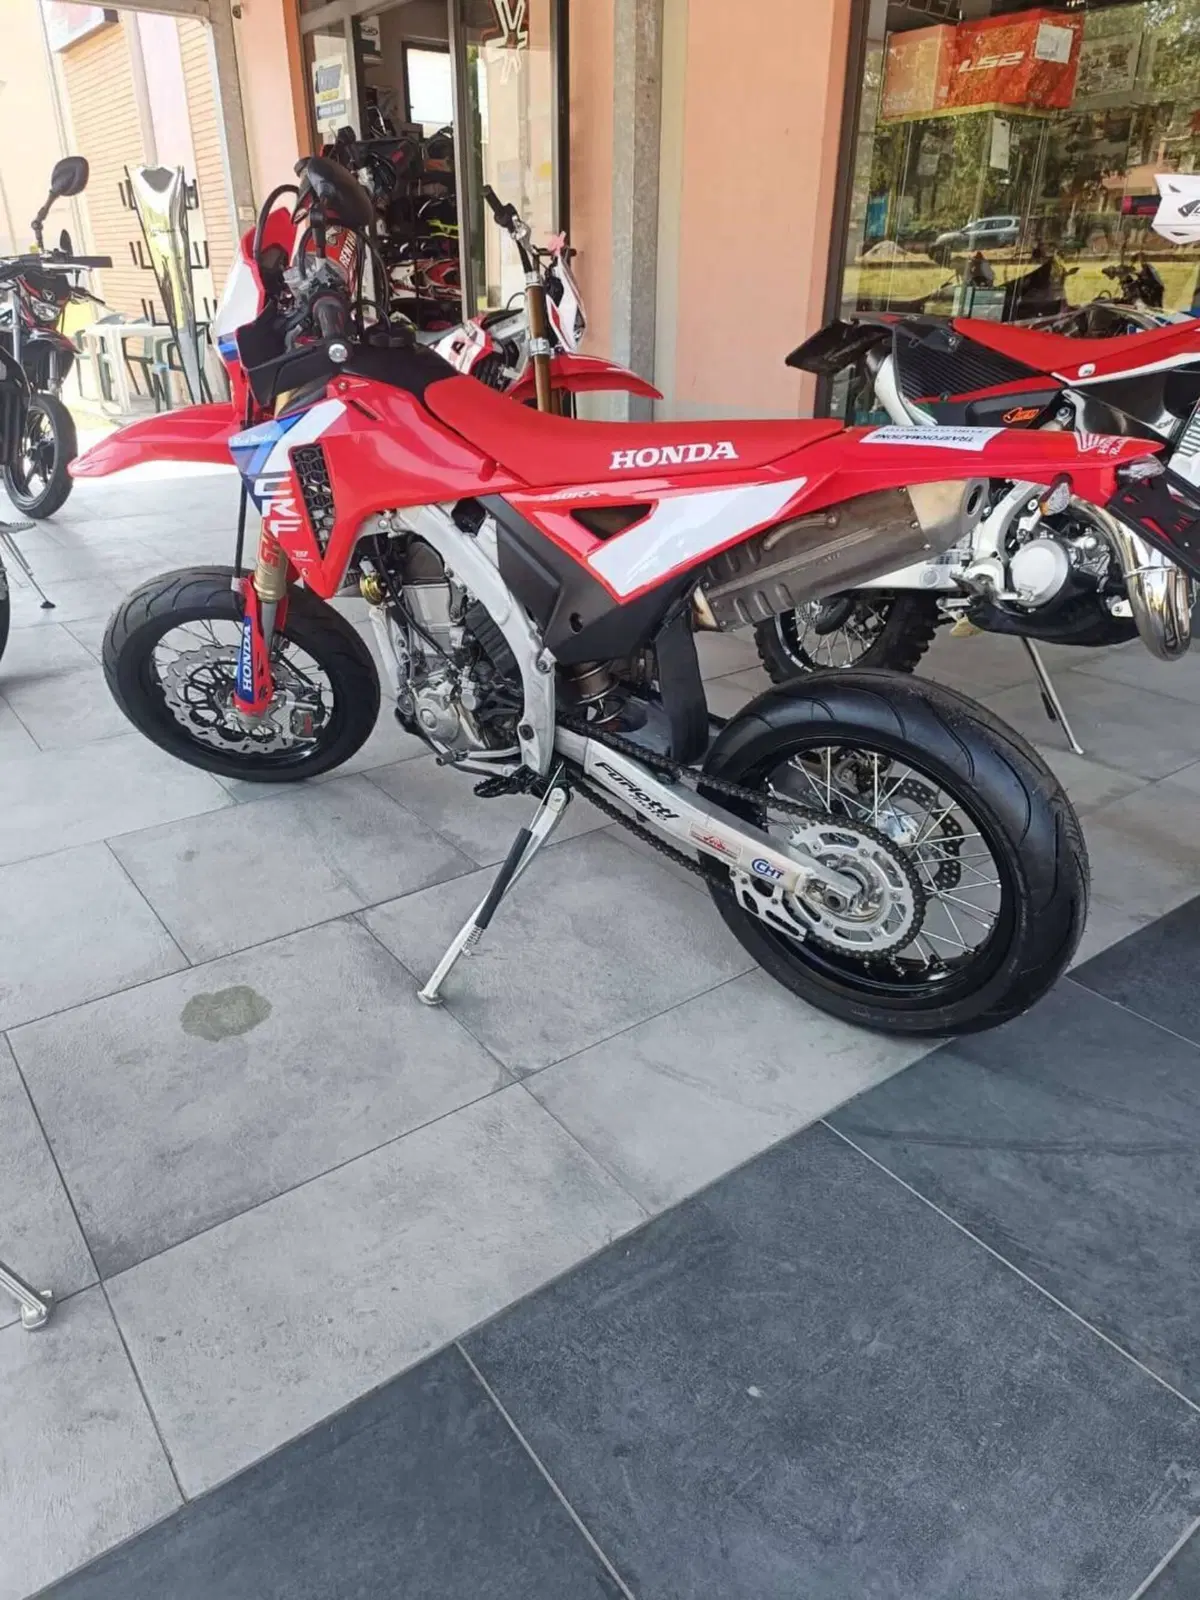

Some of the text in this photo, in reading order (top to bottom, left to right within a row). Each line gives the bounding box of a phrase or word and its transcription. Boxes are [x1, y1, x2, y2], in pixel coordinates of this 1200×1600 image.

[958, 51, 1024, 72] LS2
[608, 440, 739, 470] HONDA
[254, 476, 304, 539] CRF
[243, 624, 252, 692] HONDA
[751, 858, 785, 880] CHT
